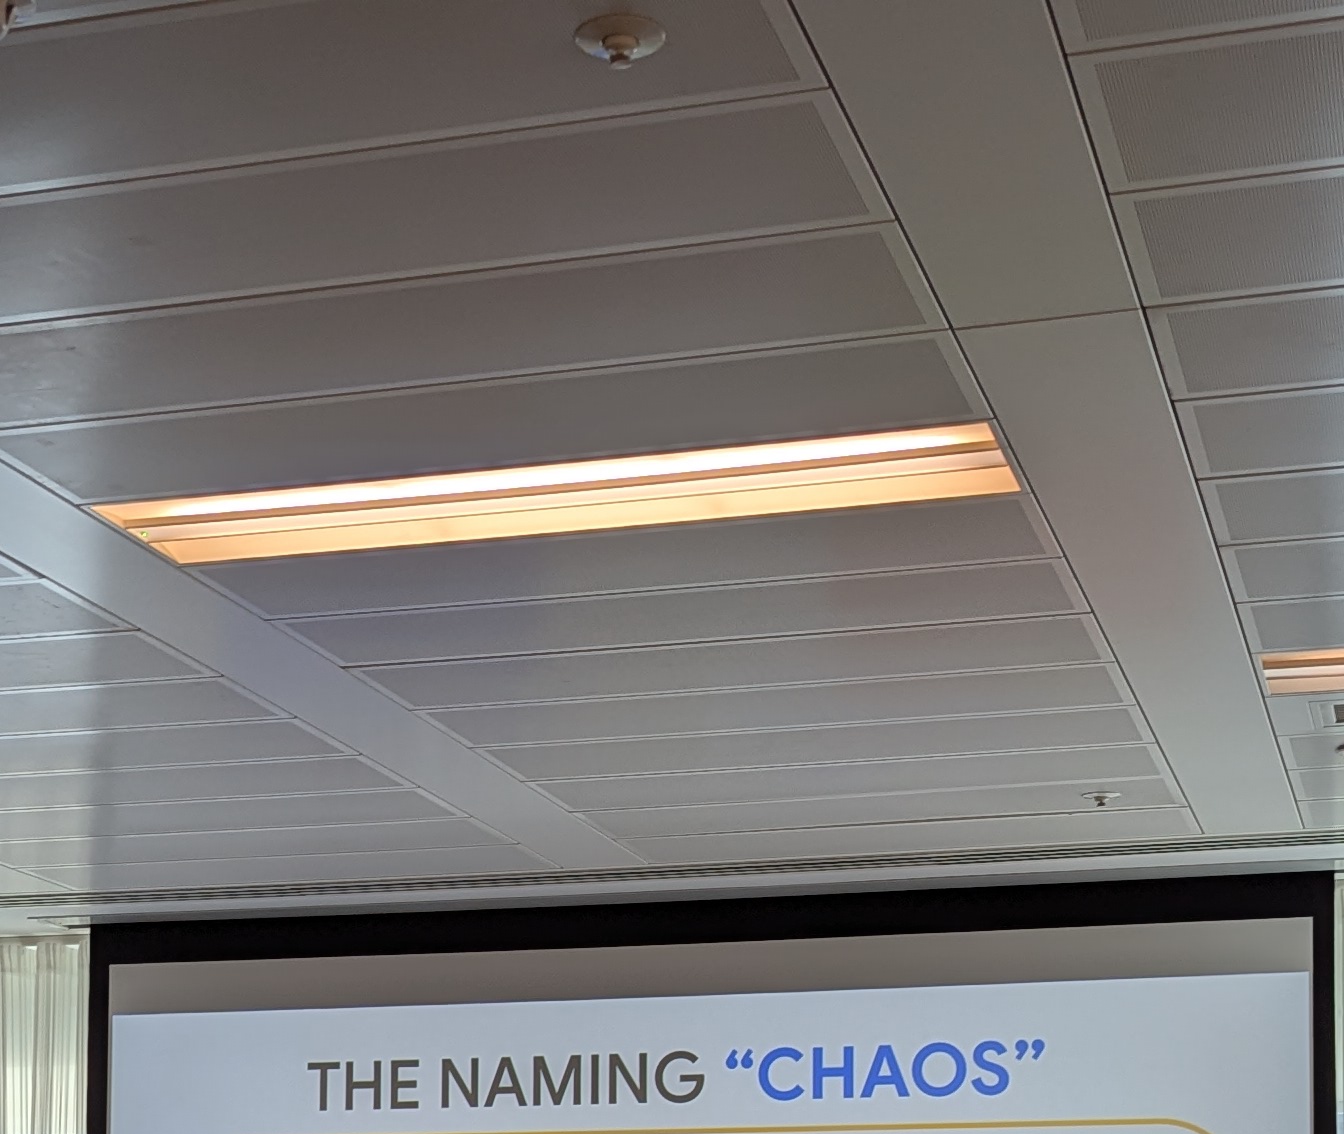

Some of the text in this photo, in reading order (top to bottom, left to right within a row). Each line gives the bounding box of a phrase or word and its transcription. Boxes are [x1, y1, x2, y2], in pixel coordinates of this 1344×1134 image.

[307, 1038, 1045, 1112] THE NAMING “CHAOS”
